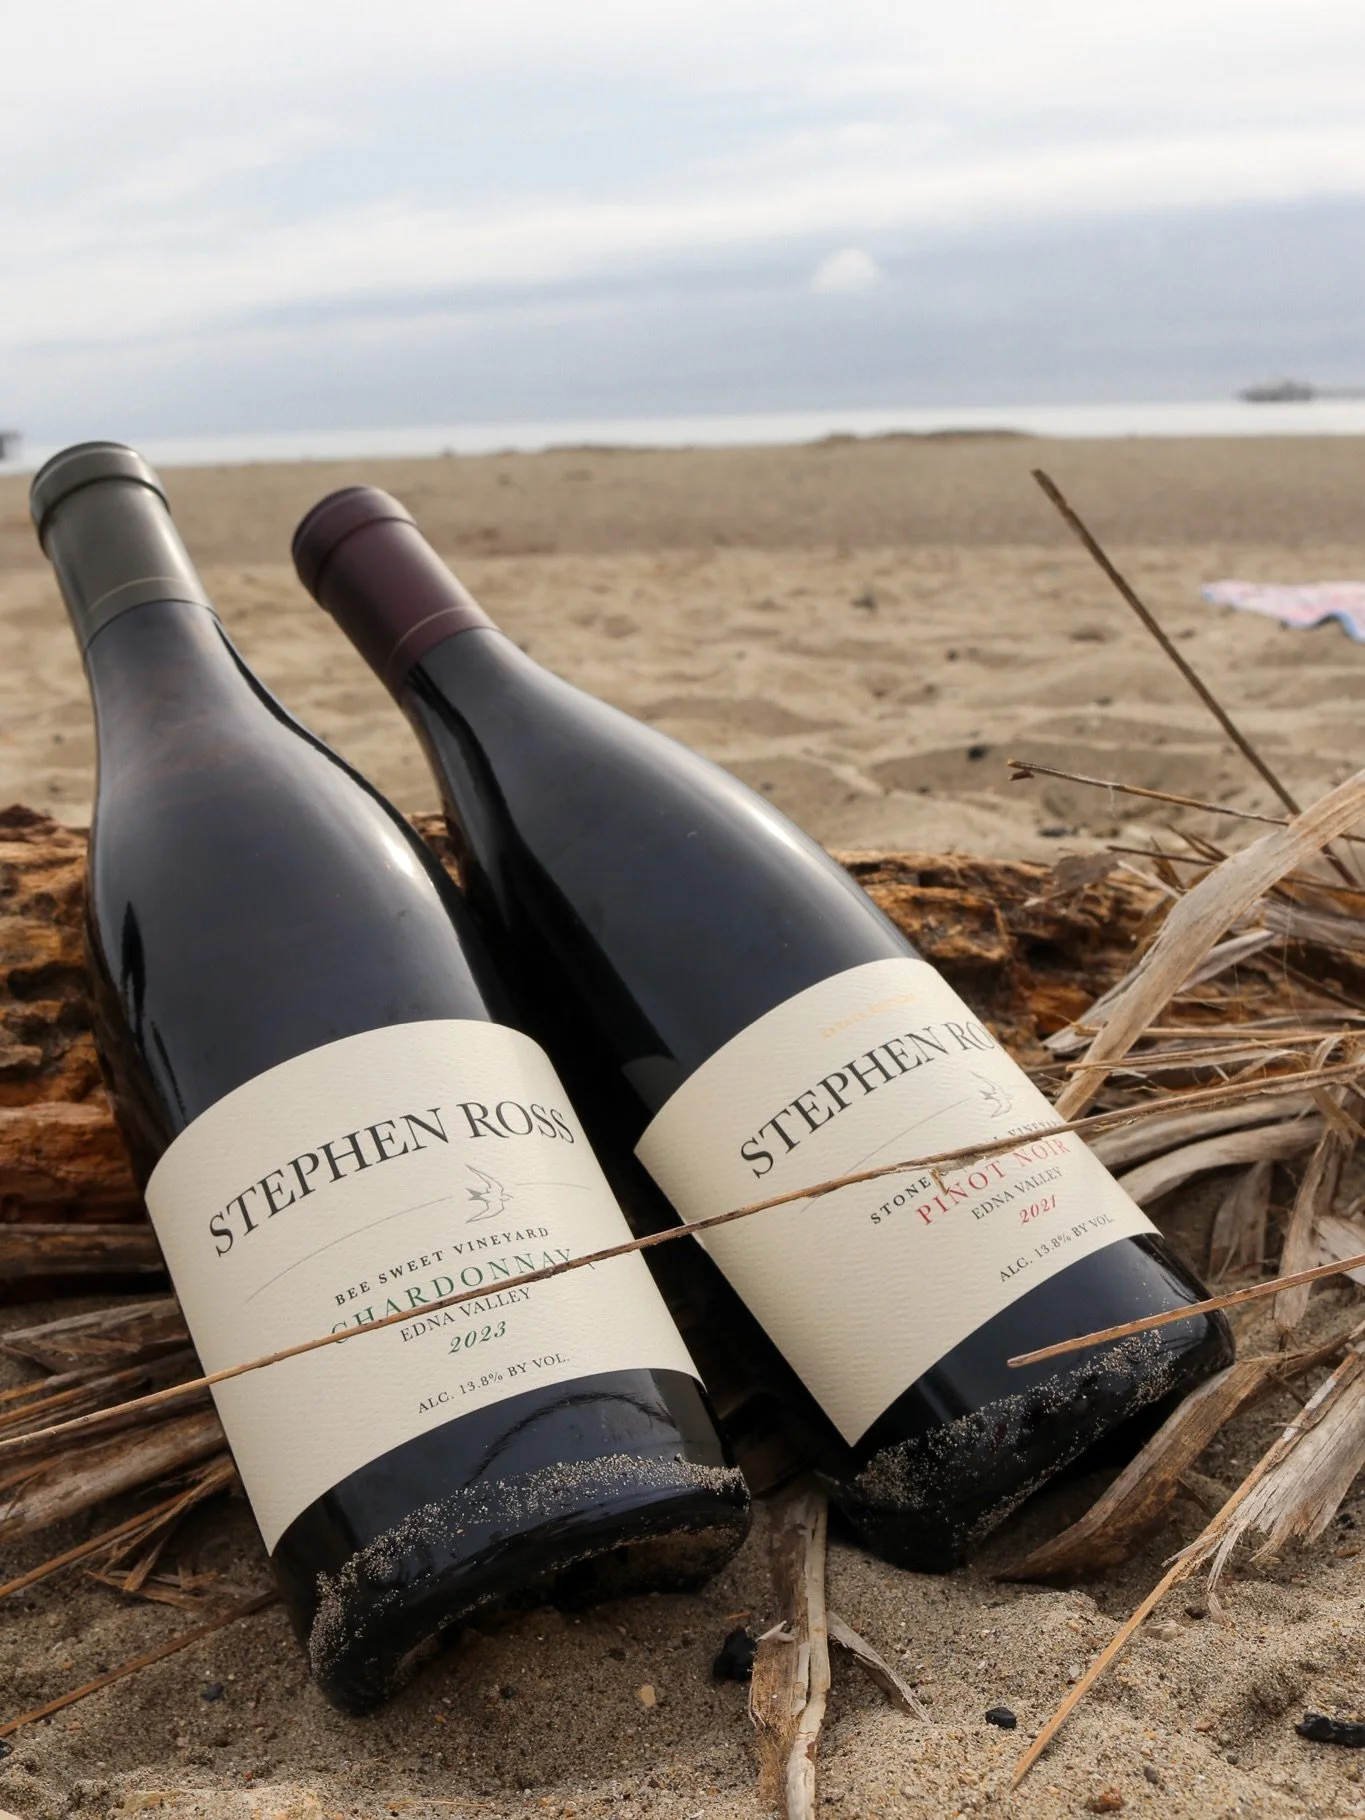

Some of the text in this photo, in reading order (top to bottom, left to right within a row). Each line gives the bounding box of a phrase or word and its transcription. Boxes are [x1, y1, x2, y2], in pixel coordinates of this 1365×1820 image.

[740, 1026, 950, 1179] STEPHEN
[209, 1101, 575, 1257] STEPHEN ROSS
[870, 1177, 931, 1224] STONE
[915, 1160, 1006, 1225] PINOT
[1013, 1139, 1071, 1167] NOIR
[971, 1166, 1063, 1220] EDNA VALLEY
[1019, 1194, 1057, 1225] 2021
[335, 1227, 549, 1306] BEE SWEET VINEYARD
[1000, 1257, 1033, 1282] ALC.
[1034, 1234, 1071, 1258] 13.8%
[1071, 1223, 1088, 1237] BY
[400, 1287, 532, 1342] EDNA VALLEY
[448, 1320, 506, 1355] 2023
[418, 1353, 570, 1414] ALC. 13.8% BY VOL.
